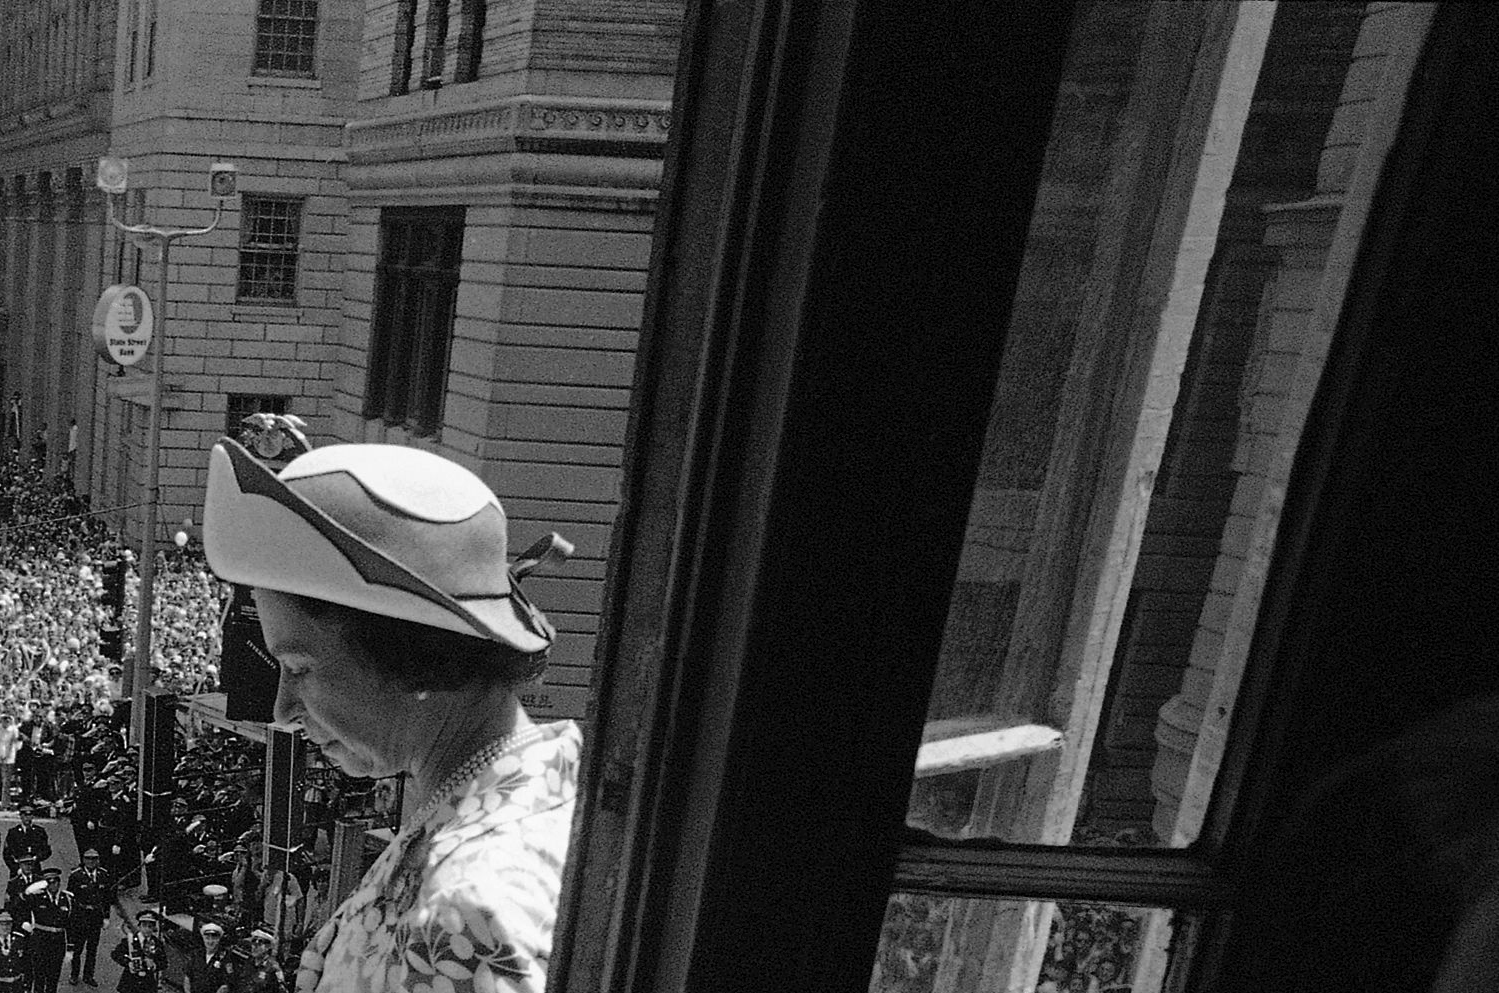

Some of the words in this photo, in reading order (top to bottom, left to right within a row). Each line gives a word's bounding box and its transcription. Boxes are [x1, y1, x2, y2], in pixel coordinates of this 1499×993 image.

[109, 338, 126, 346] State
[127, 338, 147, 346] Street
[119, 348, 135, 356] Bank
